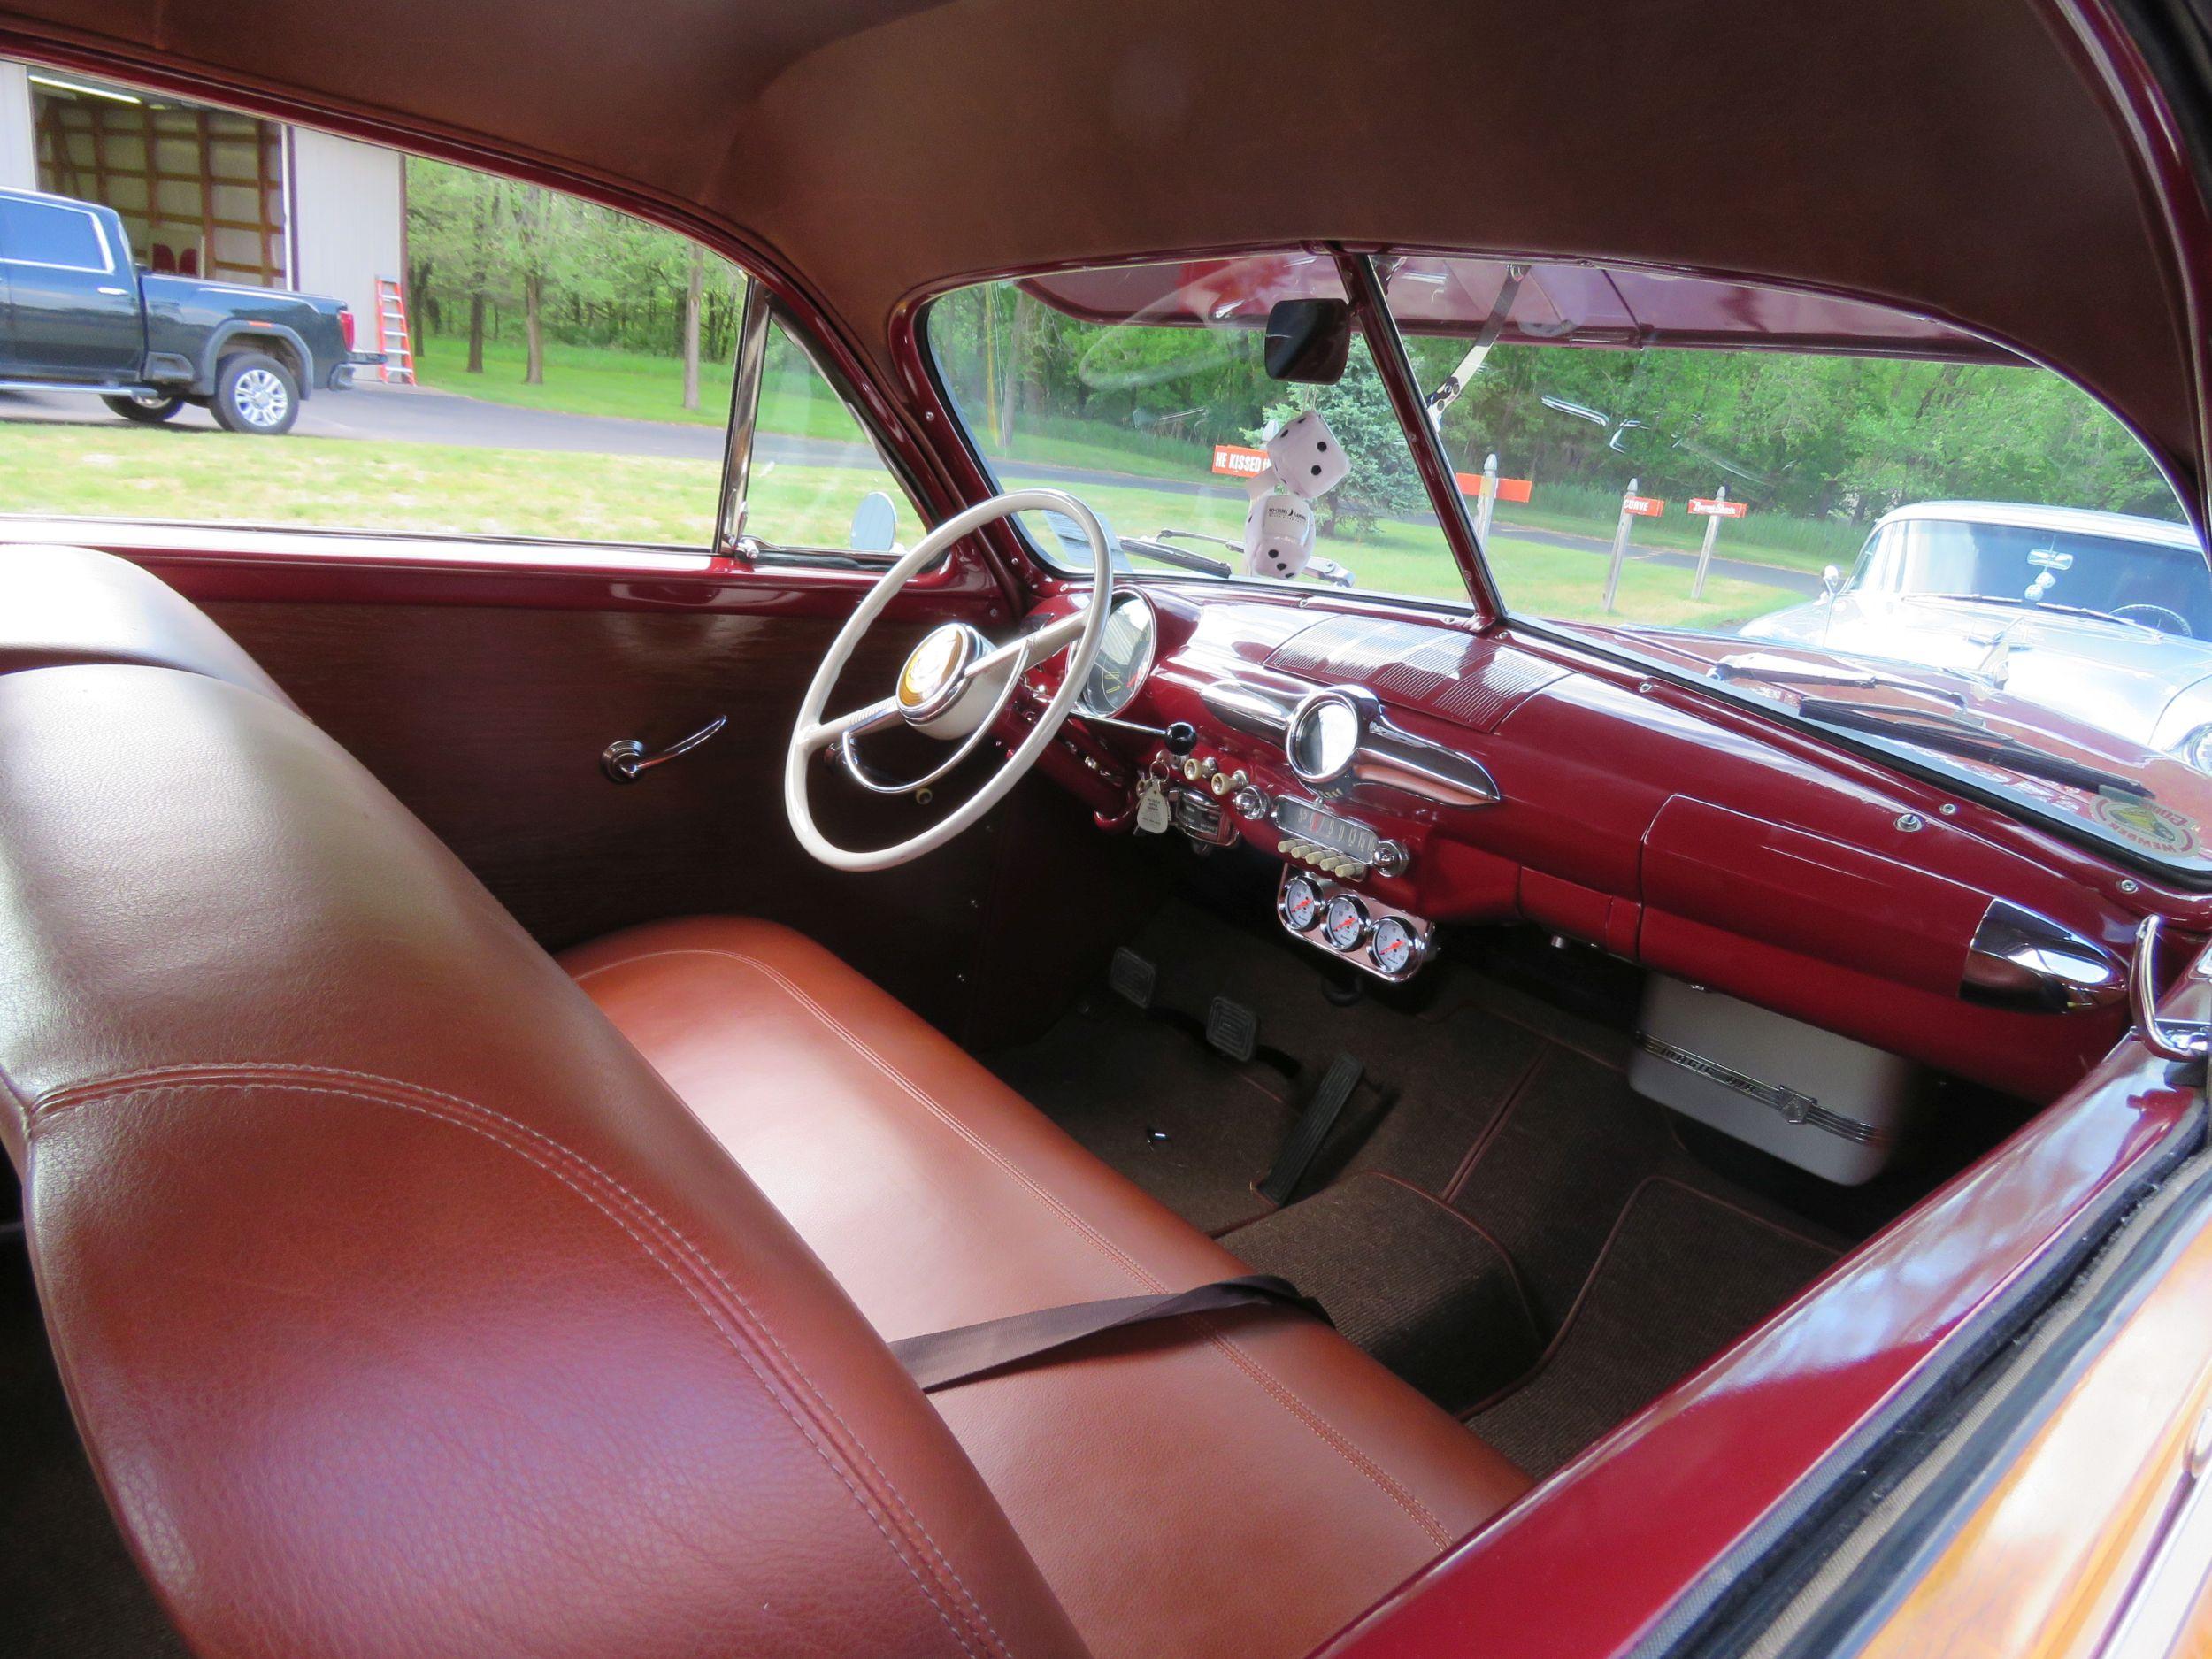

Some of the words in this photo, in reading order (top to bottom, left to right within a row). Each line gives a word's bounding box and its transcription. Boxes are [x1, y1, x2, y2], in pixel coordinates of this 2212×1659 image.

[1215, 452, 1229, 468] HE
[1229, 453, 1262, 472] KISSED
[1624, 499, 1649, 511] CURVE
